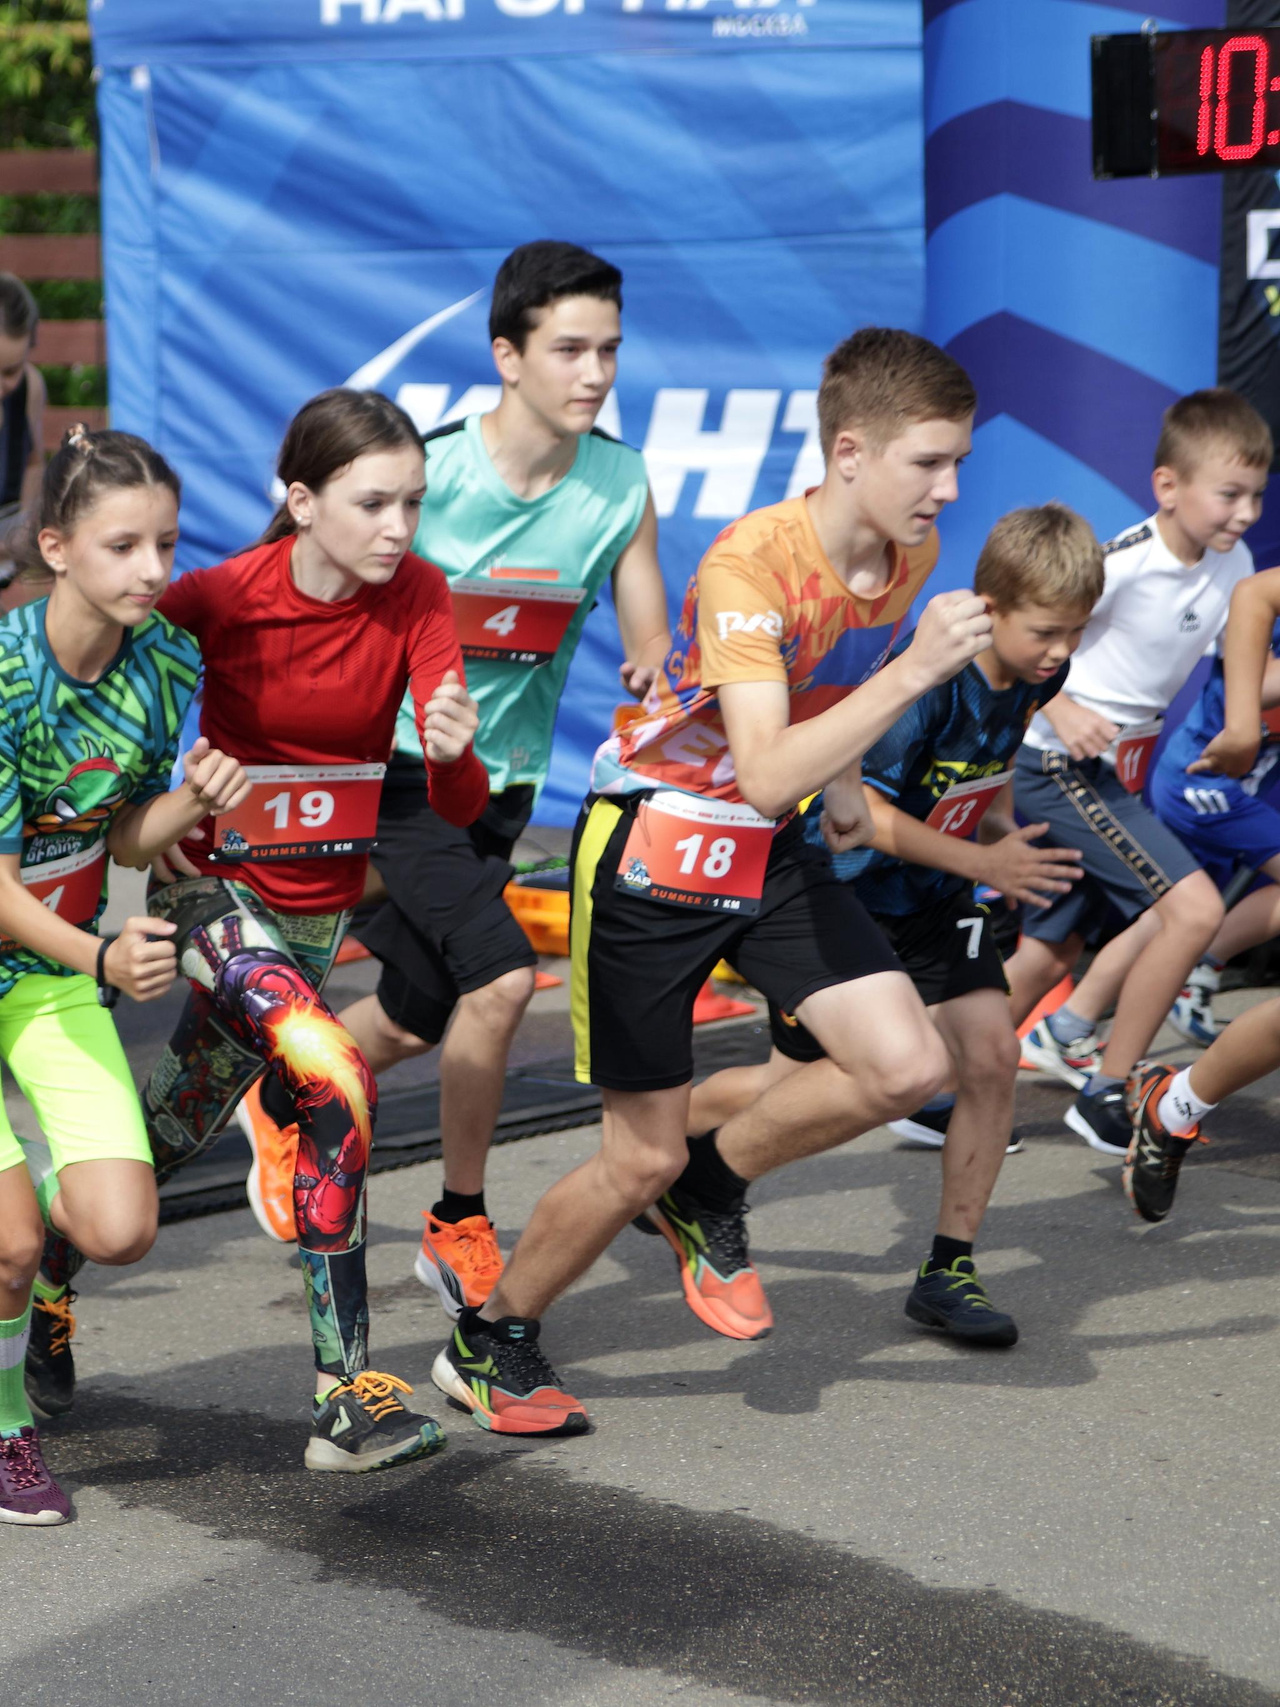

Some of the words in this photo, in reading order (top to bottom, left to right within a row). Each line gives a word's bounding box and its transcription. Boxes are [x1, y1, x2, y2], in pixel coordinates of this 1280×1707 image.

[483, 605, 520, 636] 4
[1122, 746, 1143, 780] 11
[264, 790, 335, 829] 19
[940, 799, 977, 833] 13
[221, 842, 249, 851] DAB
[251, 846, 307, 858] SUMMER
[321, 844, 328, 852] 1
[334, 842, 353, 852] KM
[674, 833, 737, 879] 18
[622, 872, 652, 886] DAB
[650, 888, 702, 905] SUMMER
[713, 898, 719, 907] 1
[722, 899, 740, 910] KM
[956, 917, 984, 959] 7
